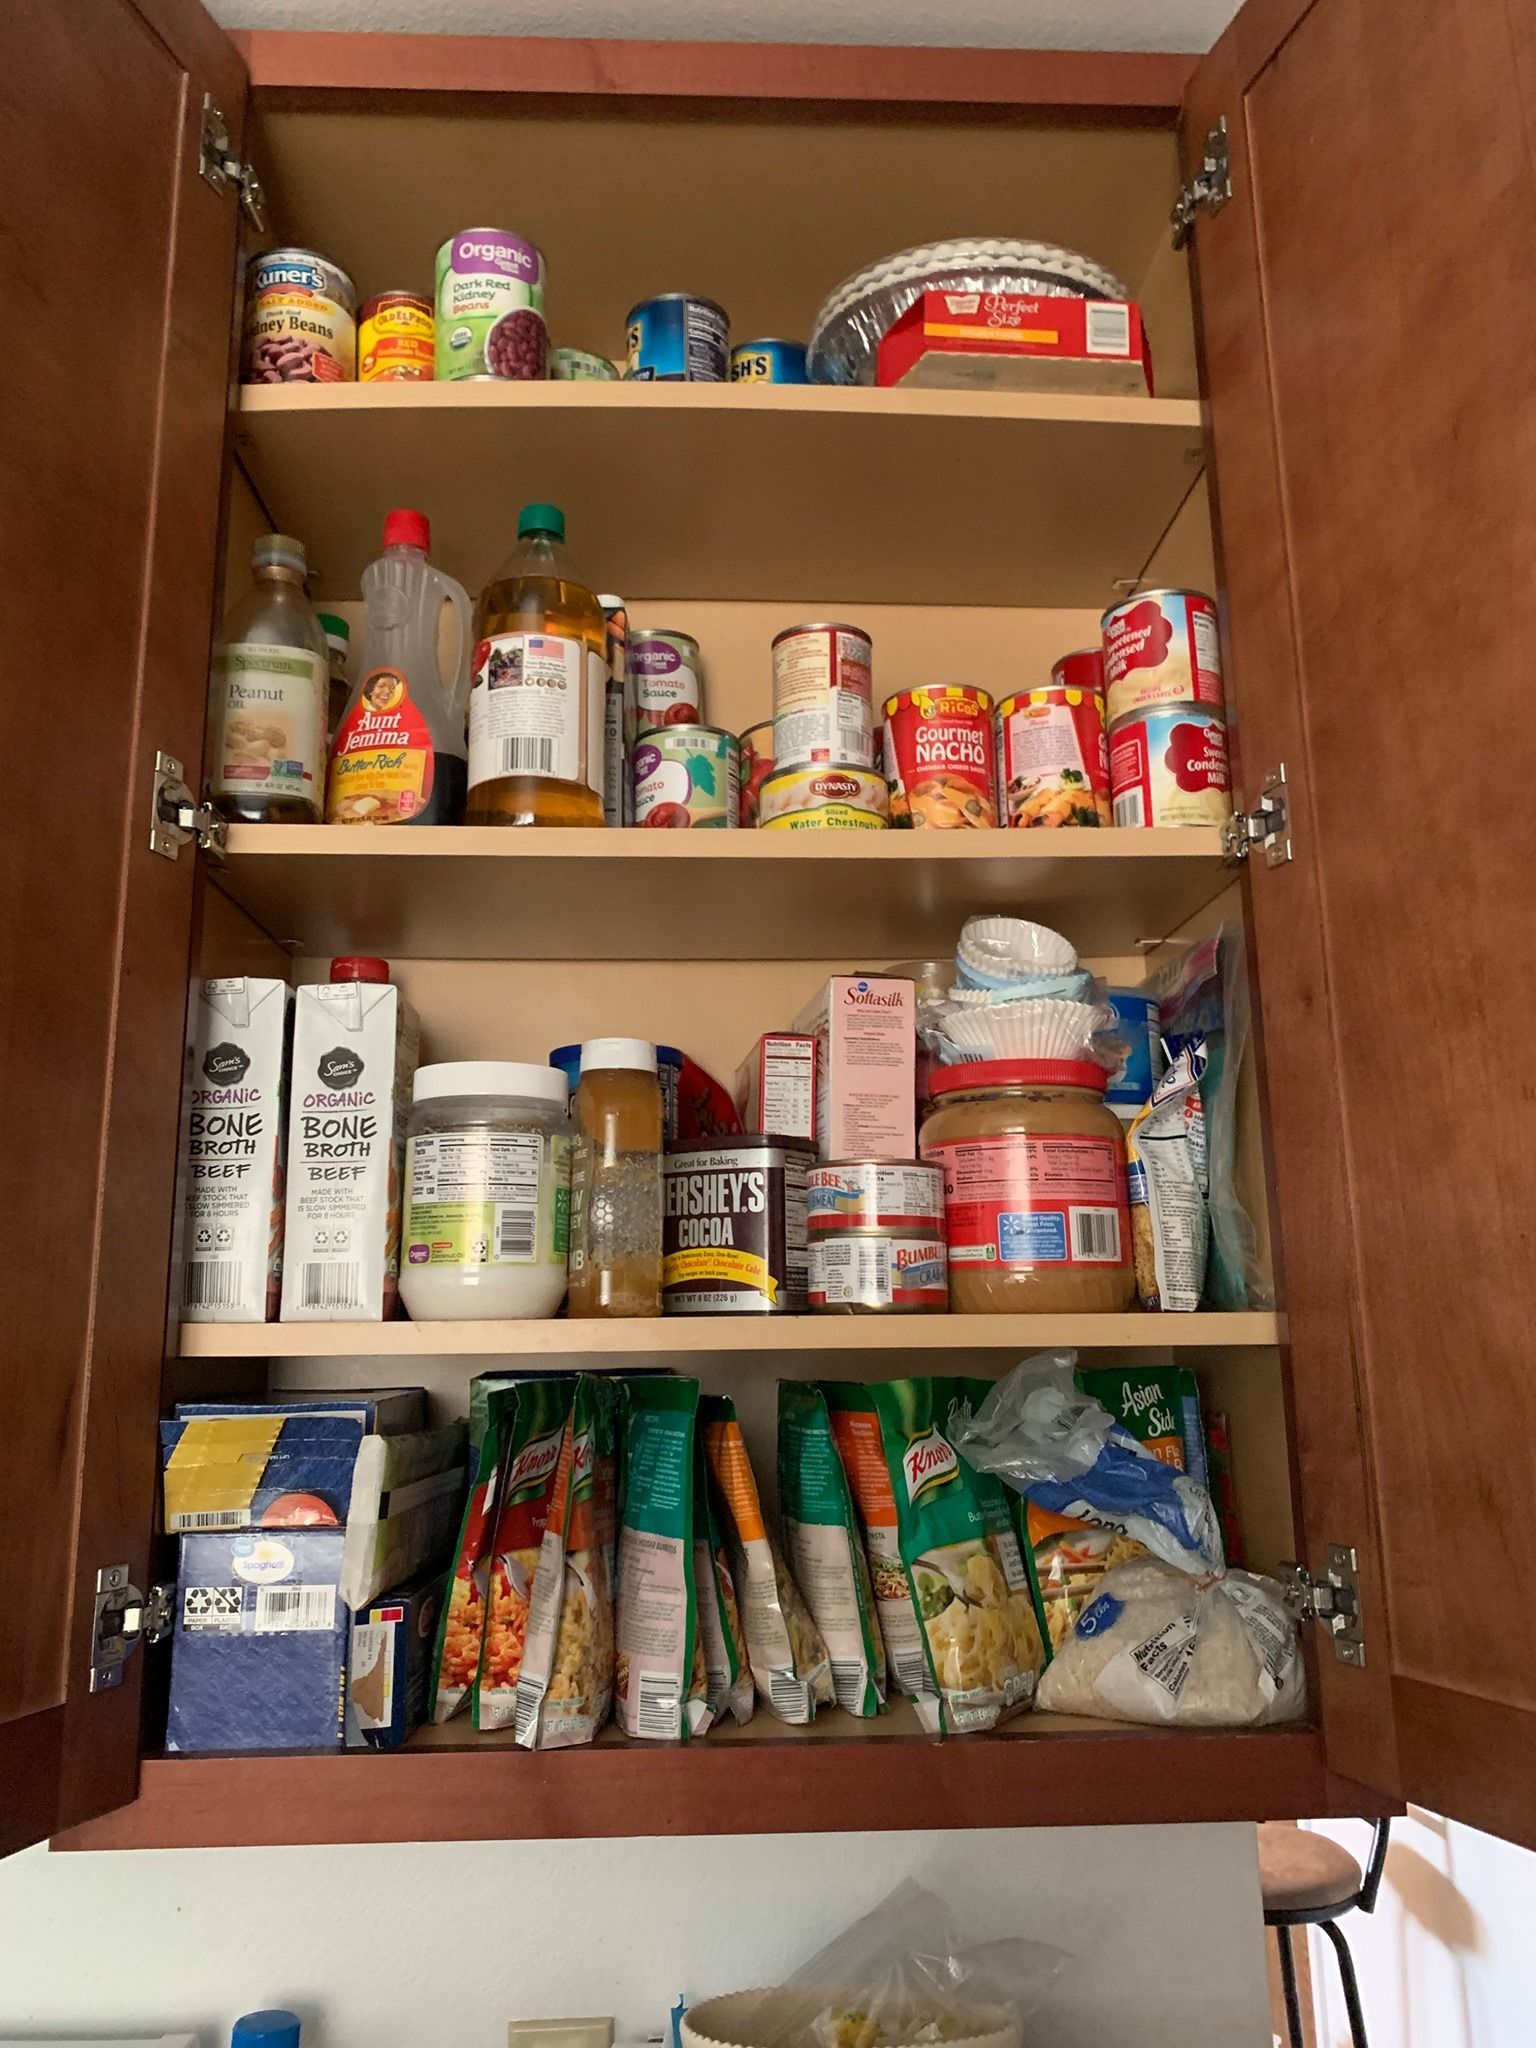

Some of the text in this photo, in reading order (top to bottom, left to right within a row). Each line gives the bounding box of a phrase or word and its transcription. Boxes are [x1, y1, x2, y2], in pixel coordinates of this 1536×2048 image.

[459, 242, 532, 268] Organic
[453, 279, 511, 293] Dark Red
[453, 290, 495, 303] Kidney
[984, 294, 1039, 316] Perfect
[453, 302, 490, 314] Beans
[987, 309, 1022, 328] Size
[253, 316, 333, 339] dney Beans
[731, 356, 767, 380] SH'S
[228, 684, 284, 701] Peanut
[641, 679, 686, 690] Tomato
[642, 689, 677, 698] Sauce
[357, 712, 402, 732] Aunt
[337, 728, 409, 755] Jemima
[915, 726, 984, 745] Gourmet
[916, 742, 985, 765] NACHO
[1187, 758, 1228, 773] Conden
[815, 782, 857, 791] DYNASTY
[790, 819, 822, 829] Water
[843, 986, 904, 1007] Softasilk
[209, 1056, 241, 1073] Sam's
[324, 1060, 355, 1077] Sam's
[190, 1112, 263, 1137] BONE
[300, 1115, 378, 1139] BONE
[189, 1139, 256, 1155] BROTH
[303, 1141, 371, 1157] BROTH
[674, 1156, 739, 1168] Great for Baking
[190, 1164, 251, 1178] BEEF
[307, 1166, 367, 1180] BEEF
[821, 1171, 841, 1188] BEE
[195, 1186, 216, 1194] MADE
[229, 1193, 248, 1201] THAT
[664, 1171, 764, 1217] ERSHEY'S
[306, 1204, 327, 1212] SLOW
[679, 1217, 734, 1248] COCOA
[1121, 1381, 1164, 1417] Asian
[243, 1560, 285, 1571] Spaghetti
[1080, 1613, 1097, 1634] 5
[1140, 1641, 1168, 1672] Facts
